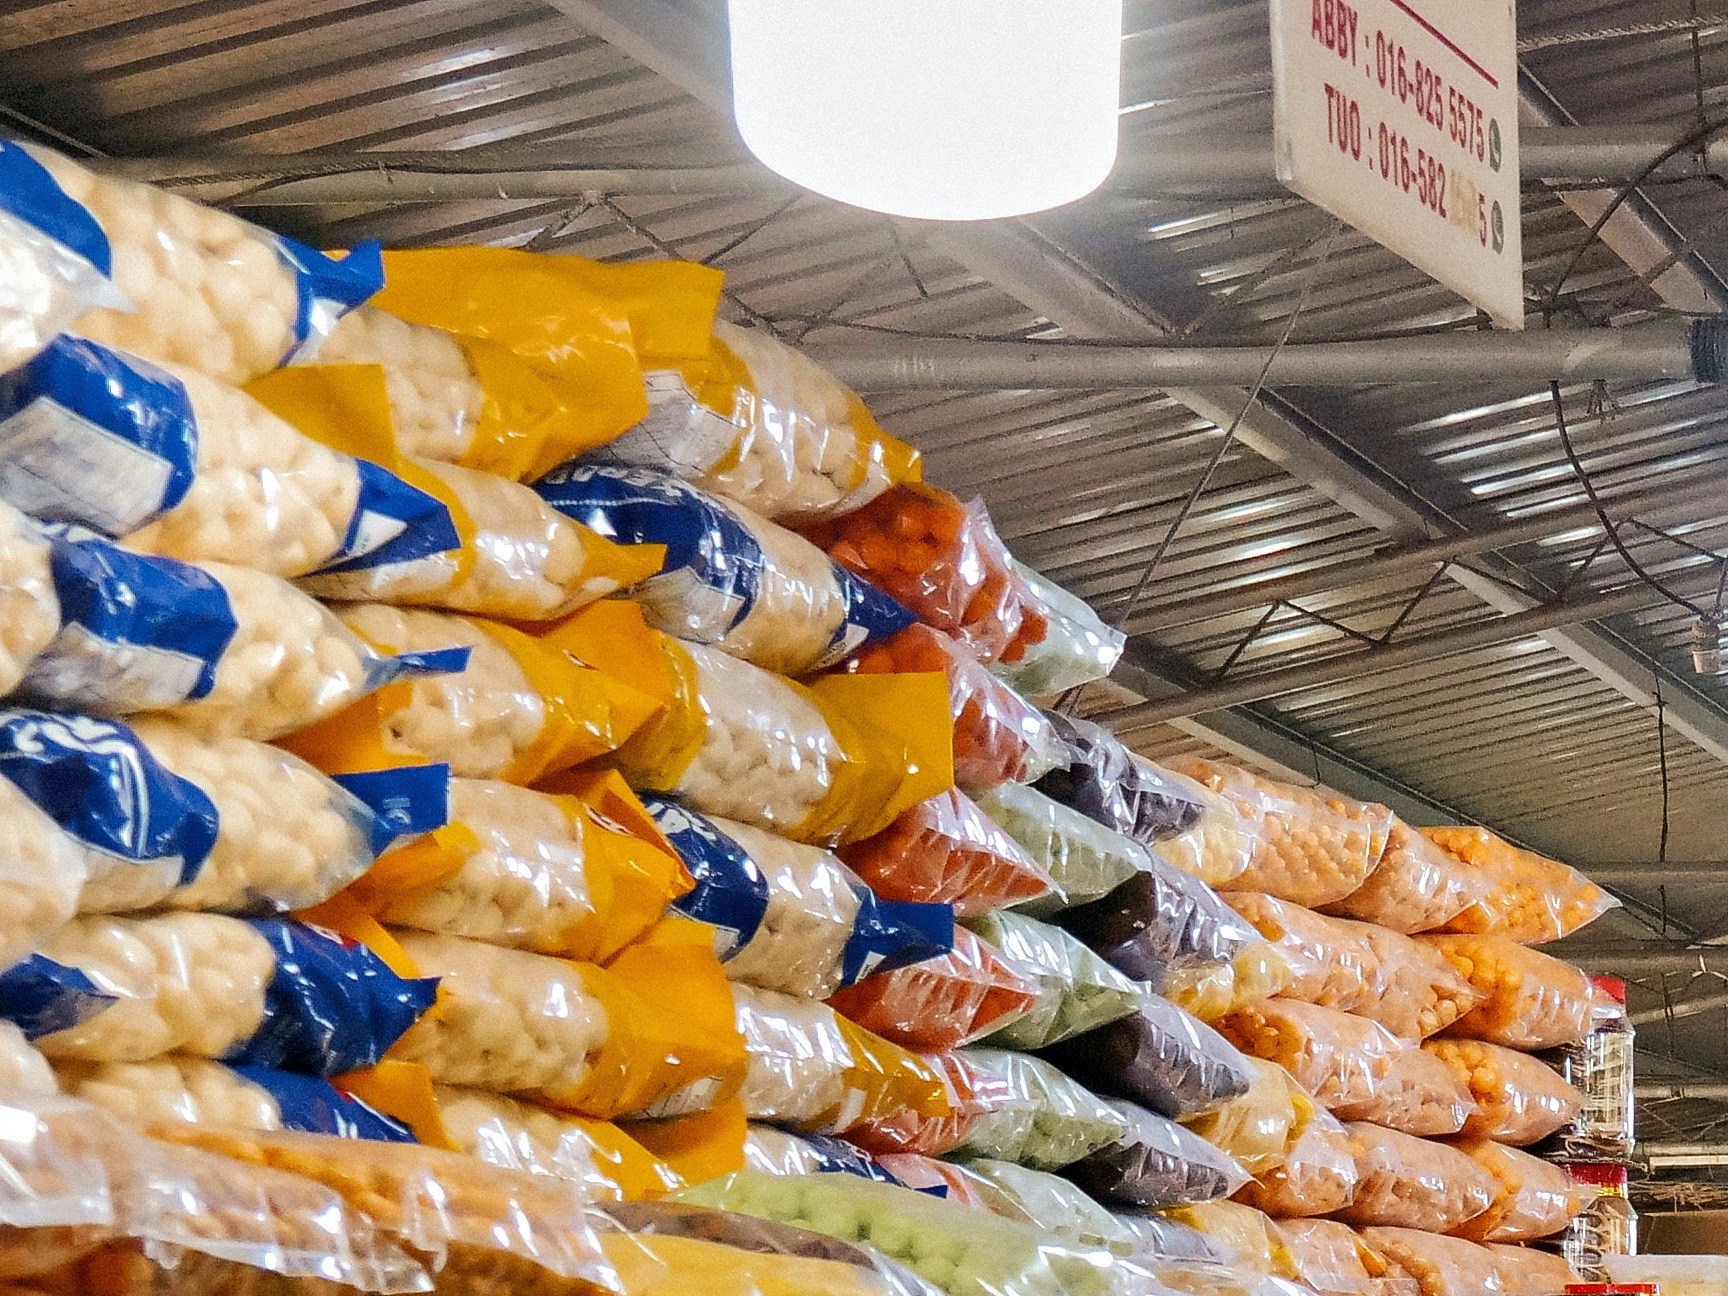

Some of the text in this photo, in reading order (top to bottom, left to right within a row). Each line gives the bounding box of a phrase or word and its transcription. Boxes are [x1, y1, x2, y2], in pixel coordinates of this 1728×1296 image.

[1312, 0, 1358, 67] ABBY
[1376, 30, 1443, 131] 016-825
[1449, 84, 1485, 163] 5575
[1324, 82, 1361, 161] TUO
[1379, 121, 1447, 219] 016-582
